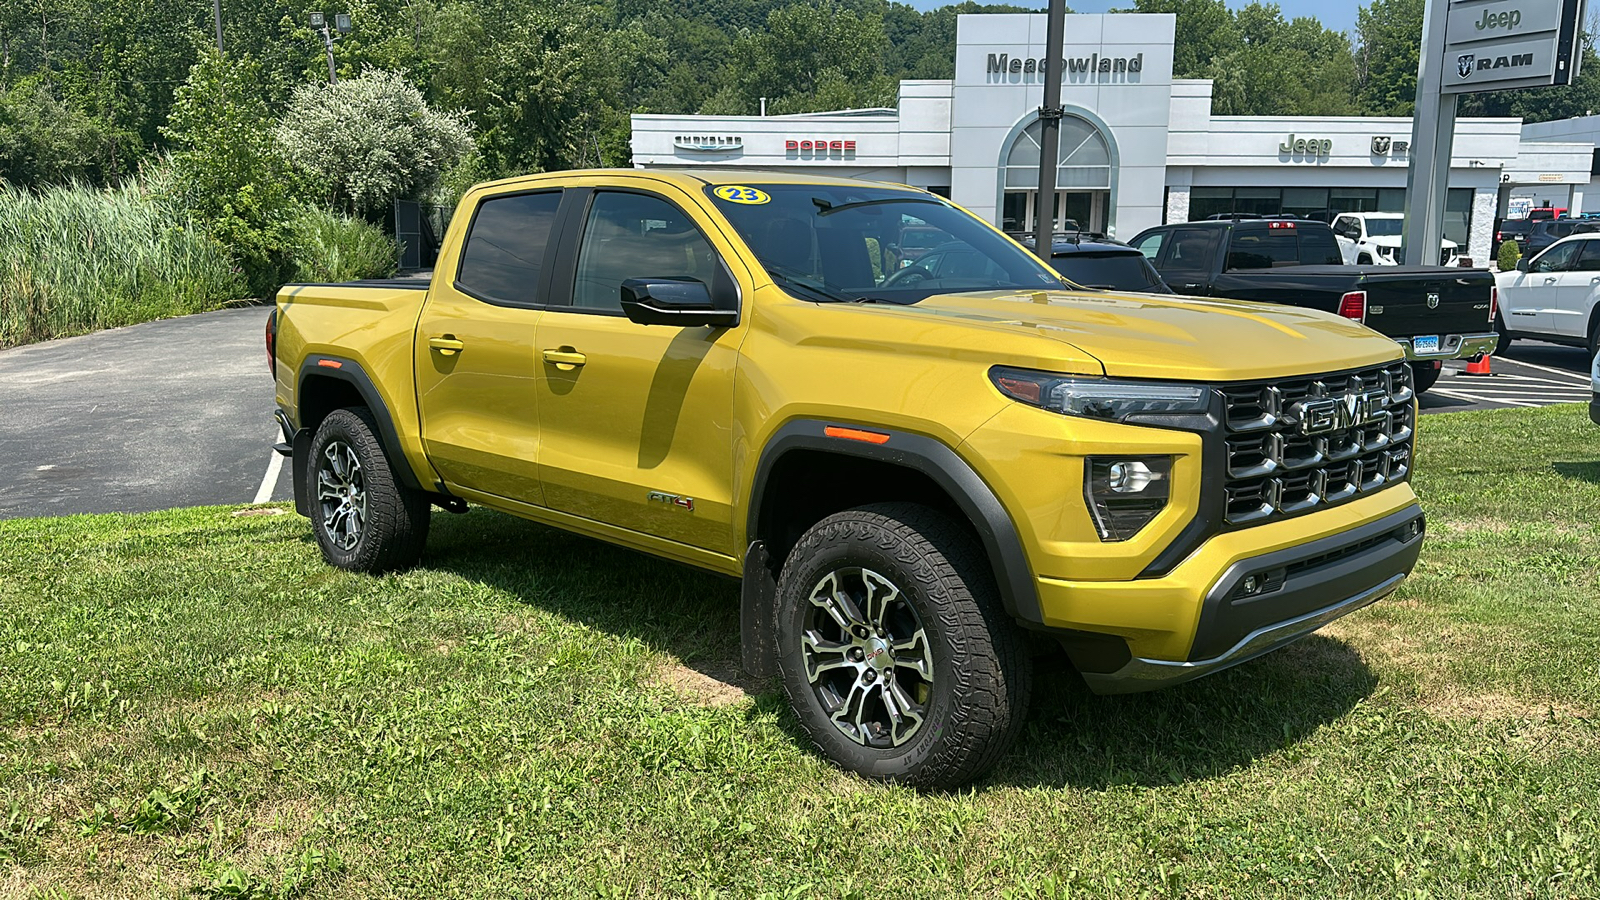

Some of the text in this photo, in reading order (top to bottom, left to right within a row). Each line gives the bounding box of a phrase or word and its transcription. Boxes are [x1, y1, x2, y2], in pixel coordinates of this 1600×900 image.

[1475, 9, 1522, 30] Jeep
[1477, 53, 1533, 71] RAM
[674, 136, 742, 144] CHRYSLER
[785, 140, 857, 150] DODGE
[1279, 134, 1333, 156] Jeep
[725, 187, 759, 201] 23
[1299, 389, 1389, 436] GMC
[646, 490, 695, 512] AT4
